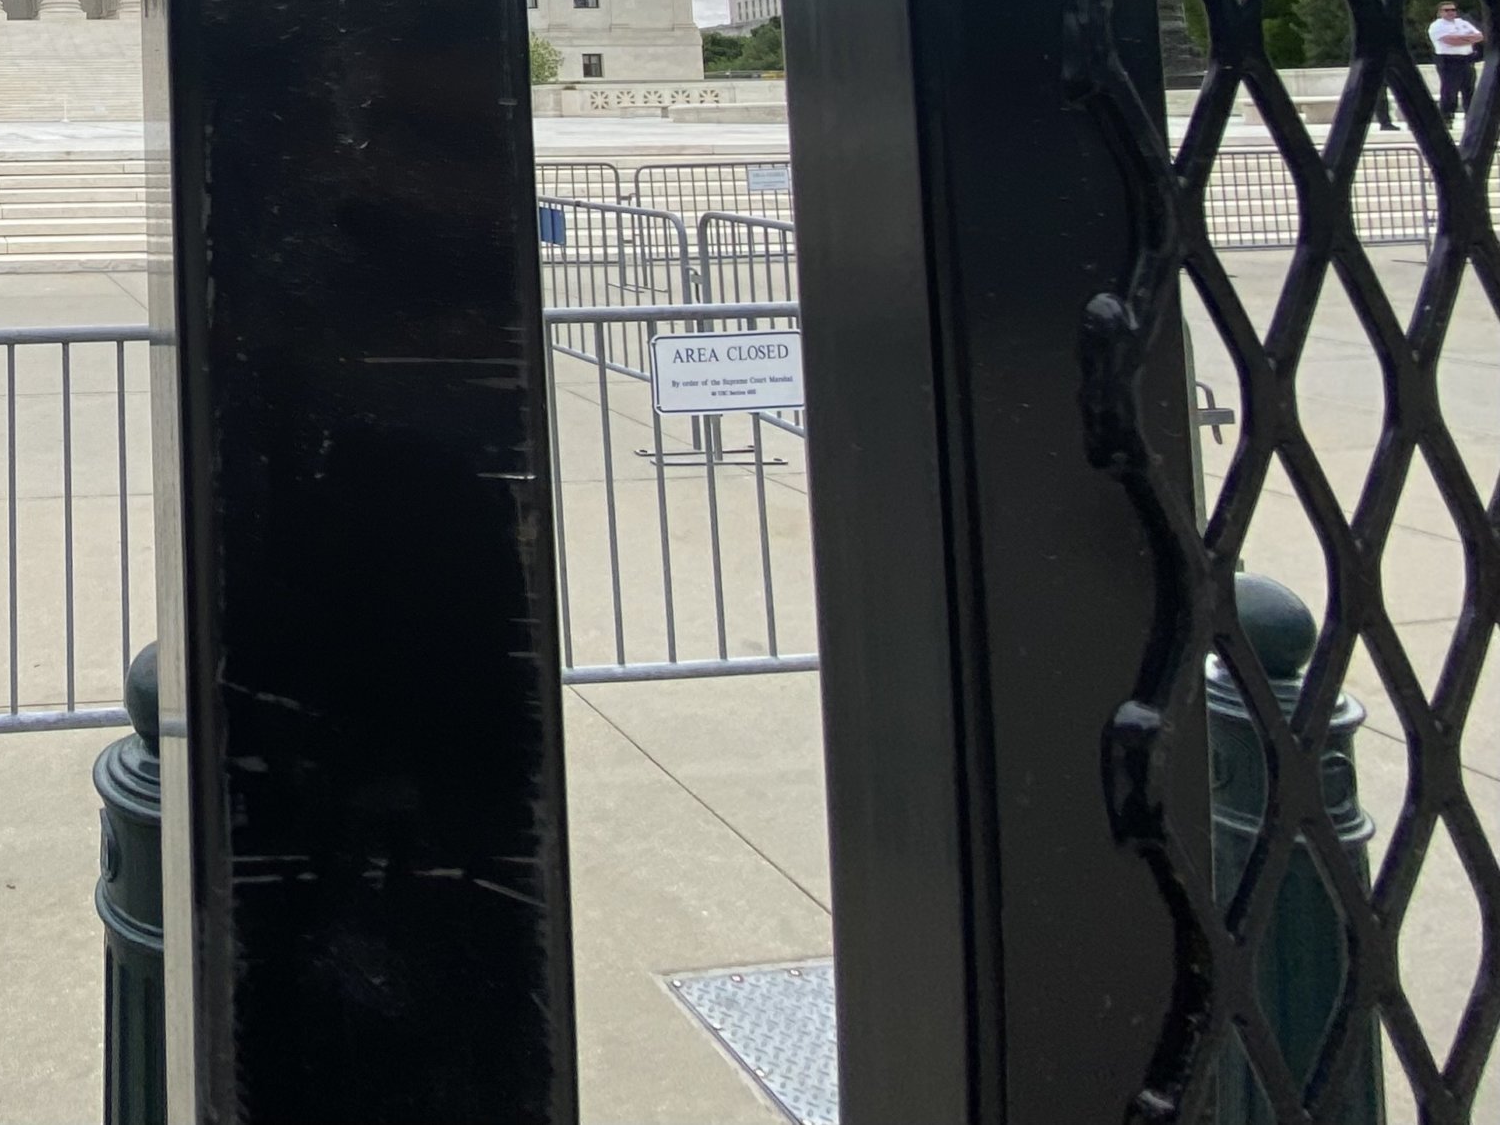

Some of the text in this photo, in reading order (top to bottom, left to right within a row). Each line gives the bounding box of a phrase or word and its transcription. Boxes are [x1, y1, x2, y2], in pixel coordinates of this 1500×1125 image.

[672, 344, 789, 363] AREA CLOSED
[671, 375, 793, 388] By order of the Supreme Court Marshal
